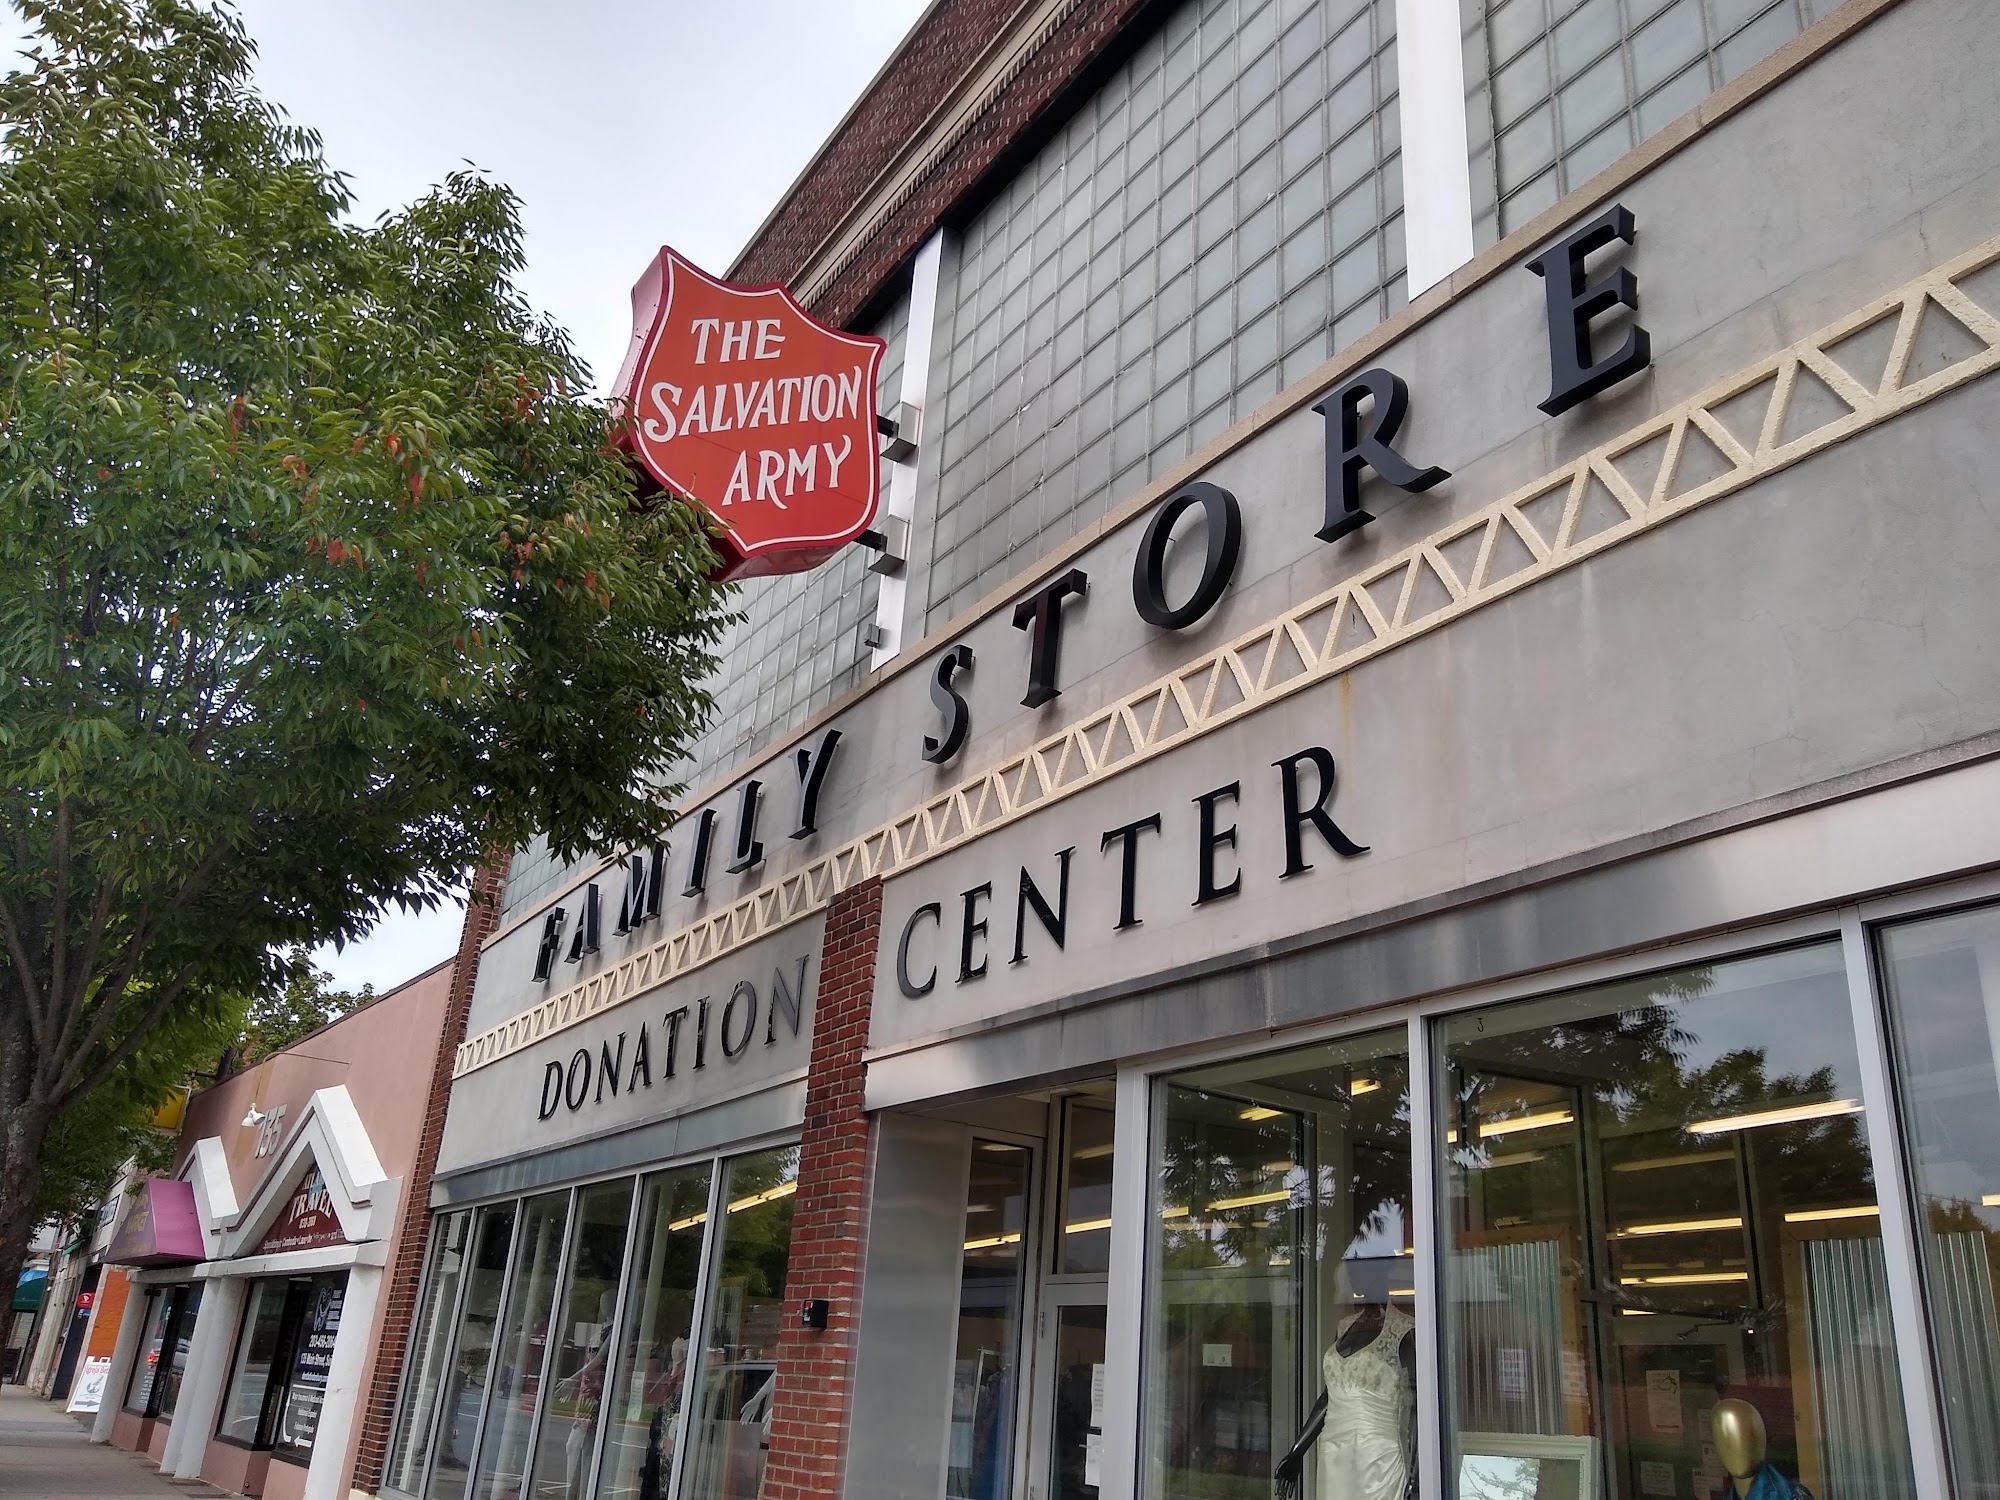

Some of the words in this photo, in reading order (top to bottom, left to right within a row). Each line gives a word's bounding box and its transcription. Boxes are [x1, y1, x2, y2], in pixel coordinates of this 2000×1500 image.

[690, 318, 786, 365] THE
[644, 365, 861, 443] SALVATION
[721, 435, 852, 510] ARMY
[531, 728, 843, 983] FAMILY
[921, 203, 1652, 765] STORE
[537, 953, 810, 1121] DONATION
[896, 746, 1371, 999] CENTER
[288, 1189, 333, 1226] TRAVEL
